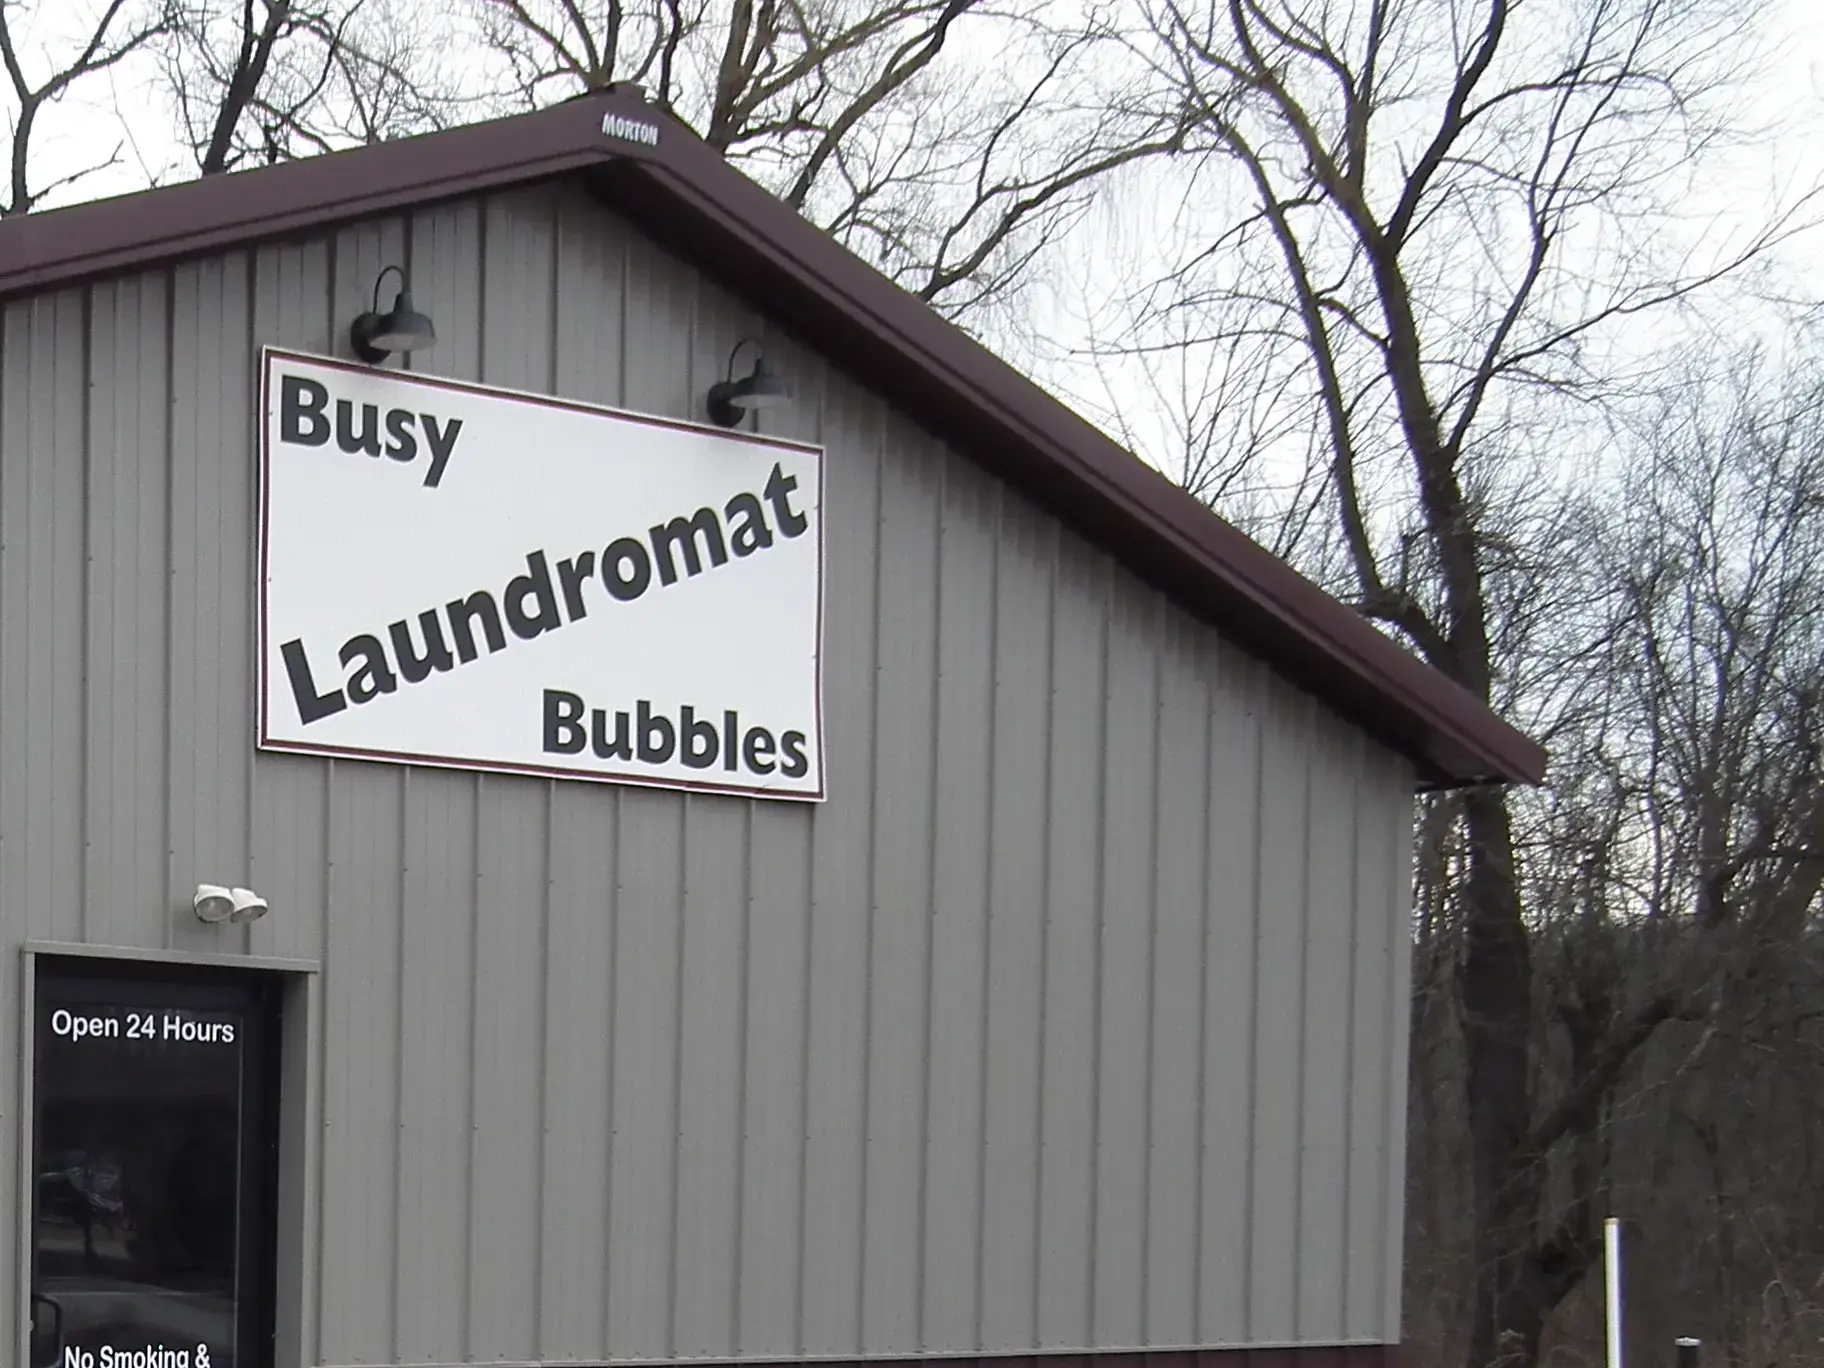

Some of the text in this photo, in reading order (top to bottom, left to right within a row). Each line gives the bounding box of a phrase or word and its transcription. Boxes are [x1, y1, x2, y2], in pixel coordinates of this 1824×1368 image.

[602, 112, 659, 146] MORTON
[280, 374, 463, 488] Busy
[279, 462, 808, 726] Laundromat
[542, 688, 809, 778] Bubbles
[51, 1009, 235, 1043] Open 24 Hours
